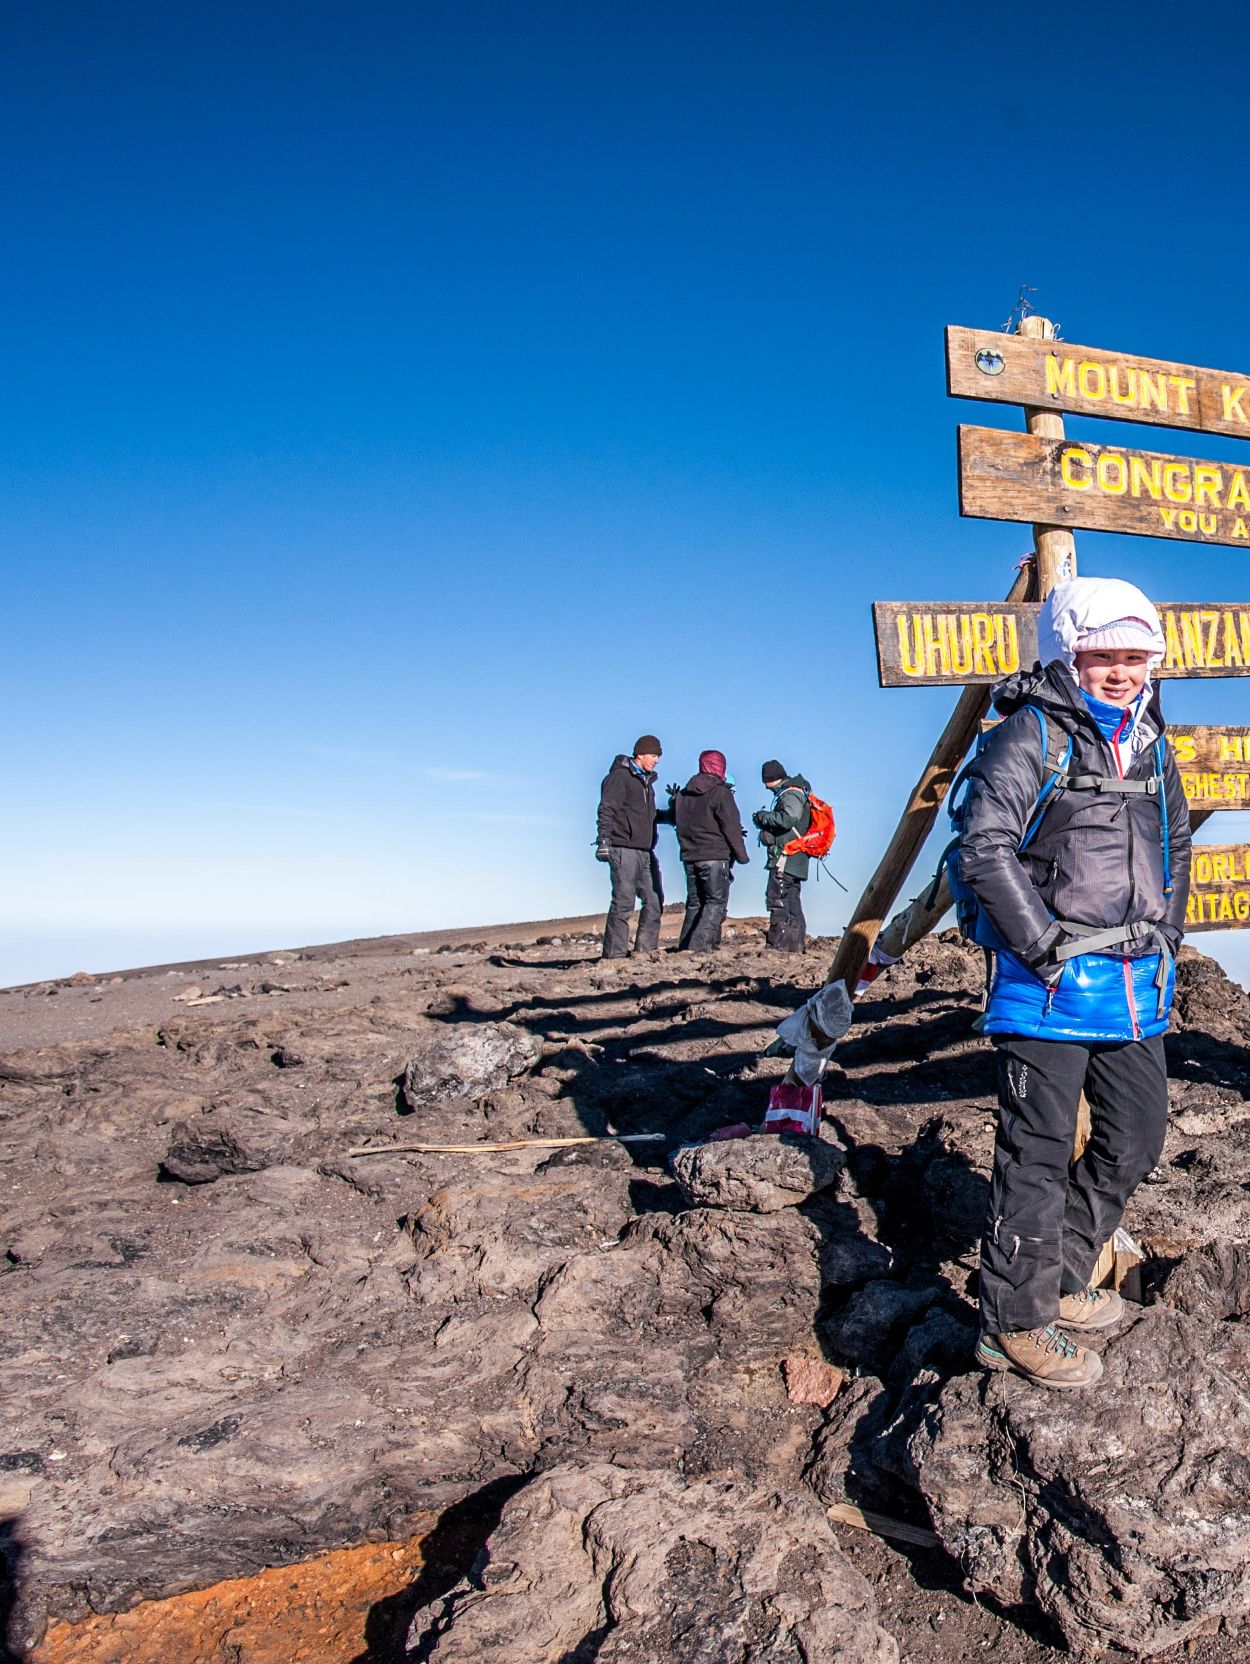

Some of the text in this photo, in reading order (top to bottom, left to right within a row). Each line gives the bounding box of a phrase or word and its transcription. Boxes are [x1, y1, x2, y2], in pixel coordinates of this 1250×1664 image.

[1046, 355, 1196, 414] MOUNT
[1159, 507, 1217, 534] YOU
[898, 613, 1020, 677] UHURU
